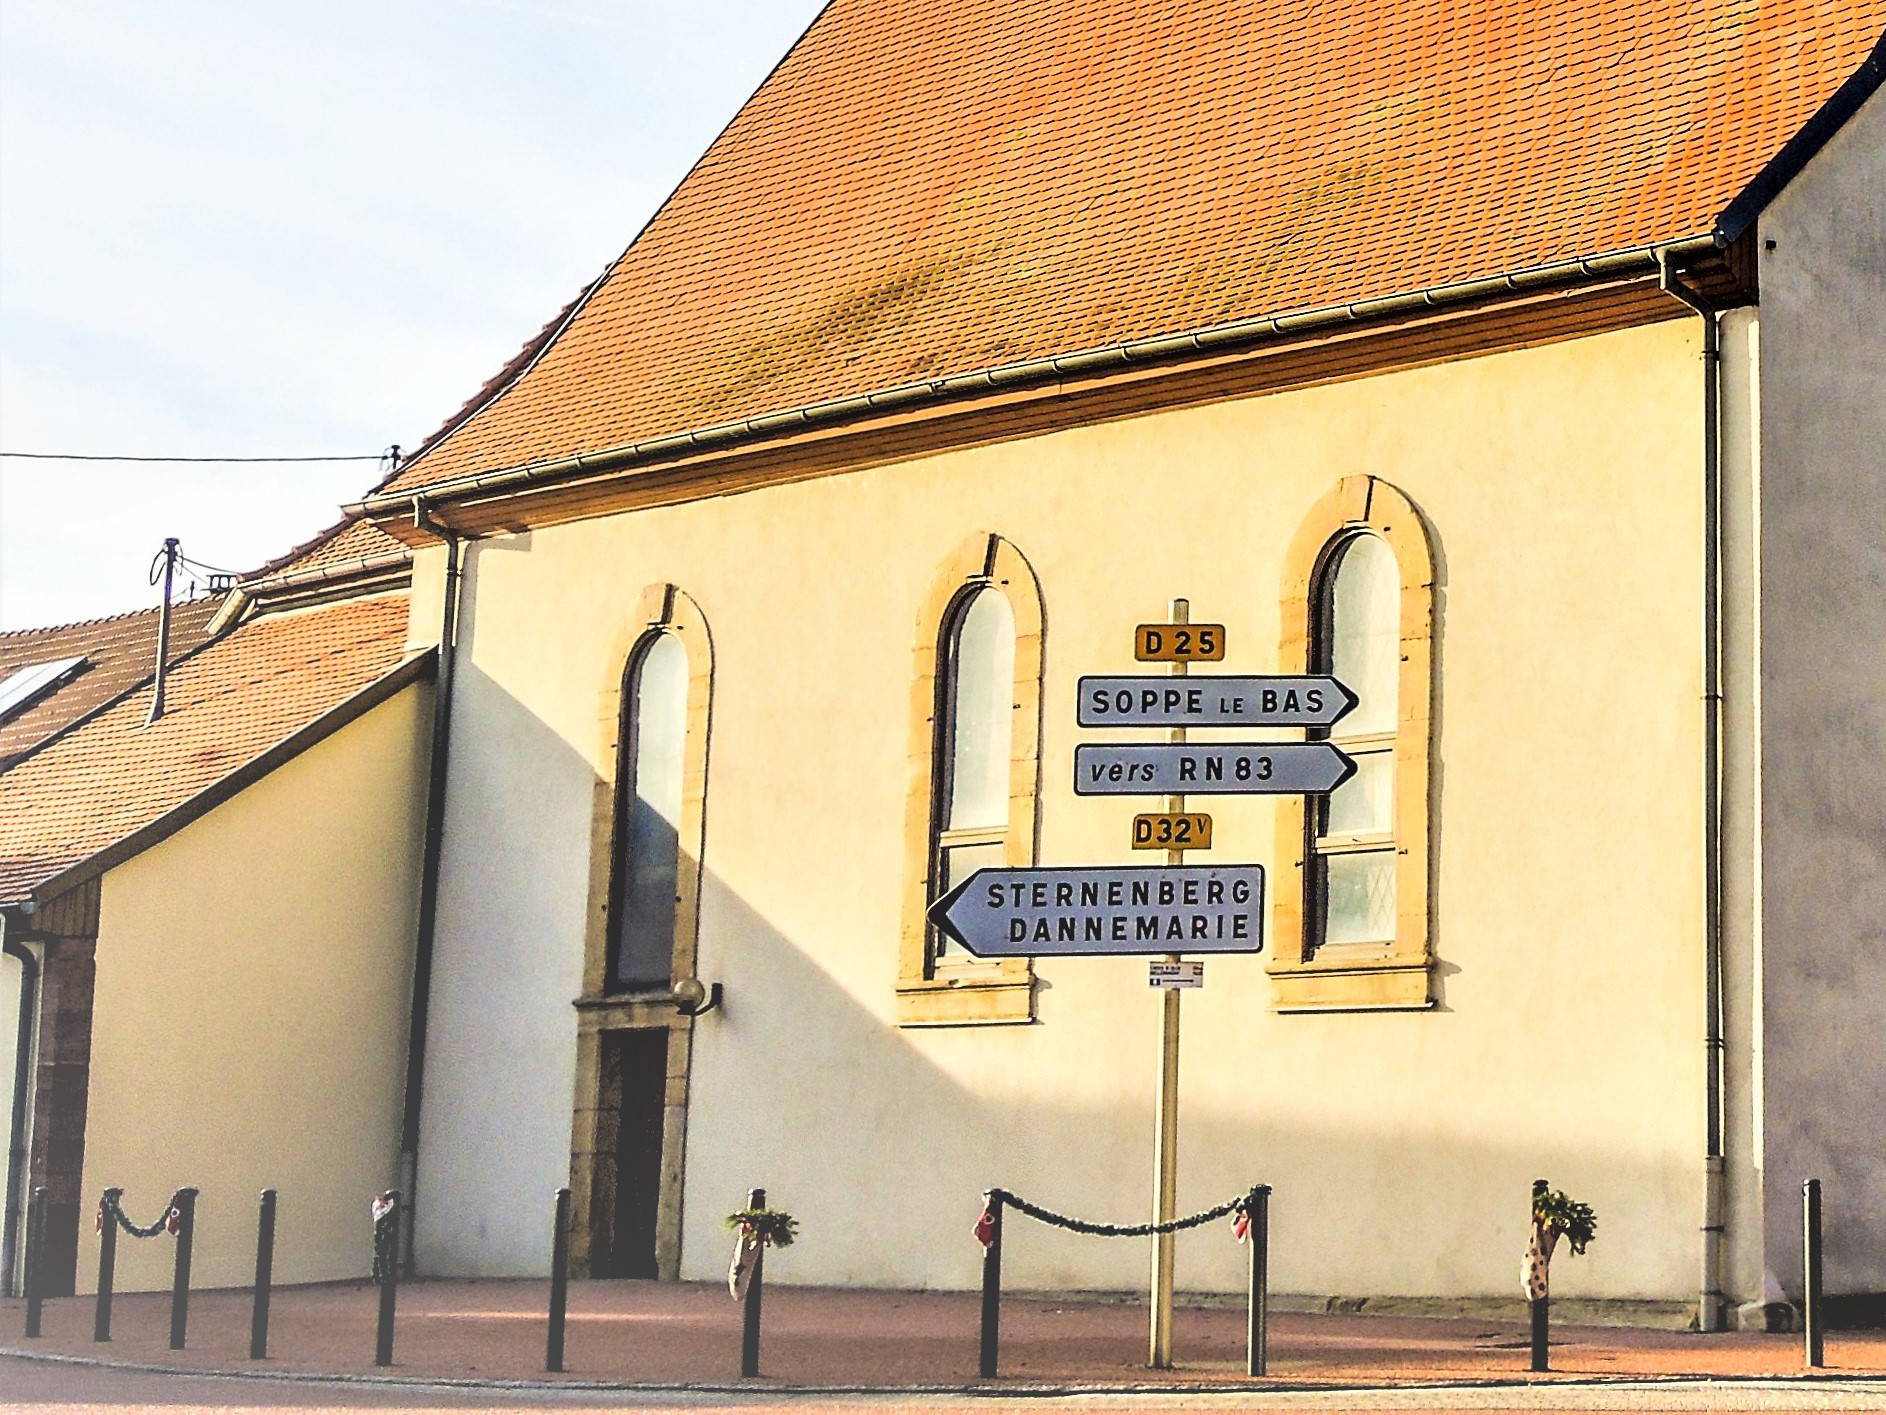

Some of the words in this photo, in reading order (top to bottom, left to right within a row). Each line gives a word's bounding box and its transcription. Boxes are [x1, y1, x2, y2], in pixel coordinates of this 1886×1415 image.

[1145, 630, 1163, 655] D
[1174, 630, 1215, 655] 25
[1091, 689, 1203, 714] SOPPE
[1219, 697, 1244, 714] LE
[1261, 689, 1324, 714] BAS
[1091, 762, 1155, 783] vers
[987, 879, 1250, 909] STERNENBERG
[1009, 914, 1249, 943] DANNEMARIE
